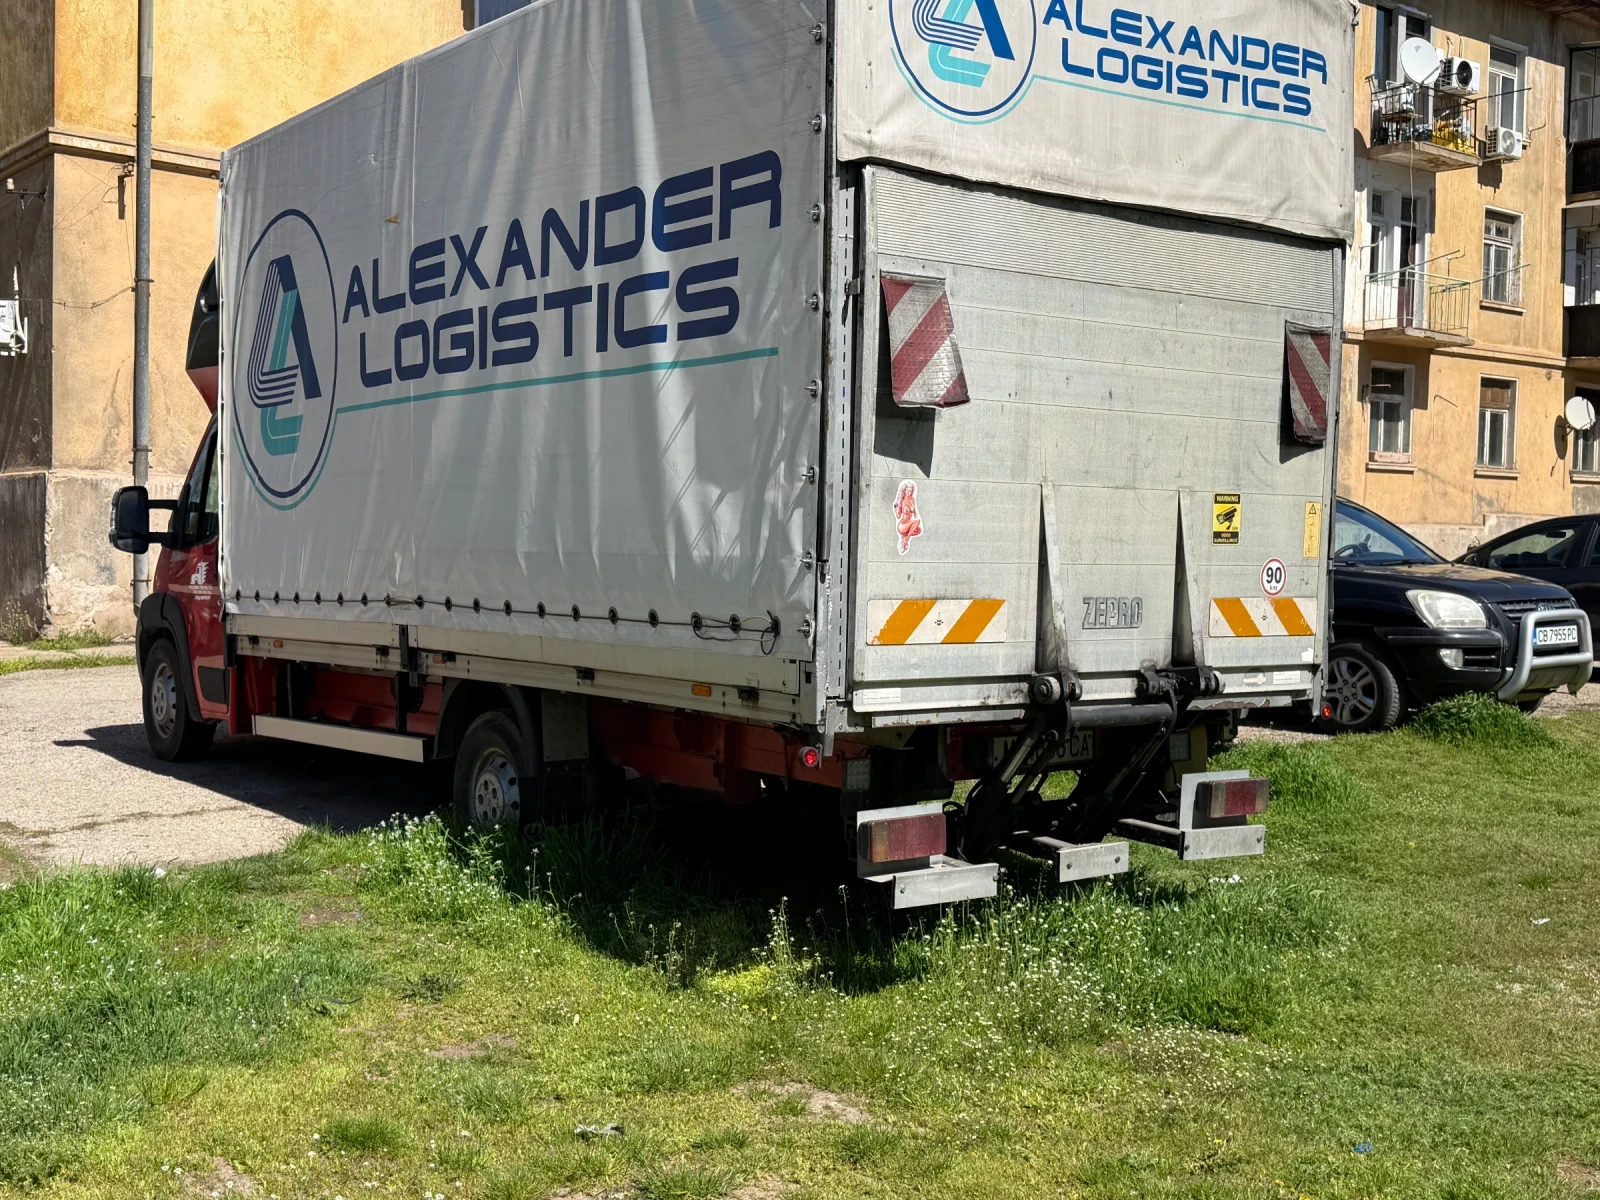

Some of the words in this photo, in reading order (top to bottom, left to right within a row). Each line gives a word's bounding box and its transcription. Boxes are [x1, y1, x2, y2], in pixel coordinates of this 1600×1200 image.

[1042, 0, 1328, 86] ALEXANDER
[1061, 37, 1312, 117] LOGISTICS
[342, 149, 782, 324] ALEXANDER
[359, 257, 740, 388] LOGISTICS
[1216, 495, 1239, 503] WARNING
[1081, 596, 1143, 630] ZEPRO
[1266, 566, 1282, 584] 90
